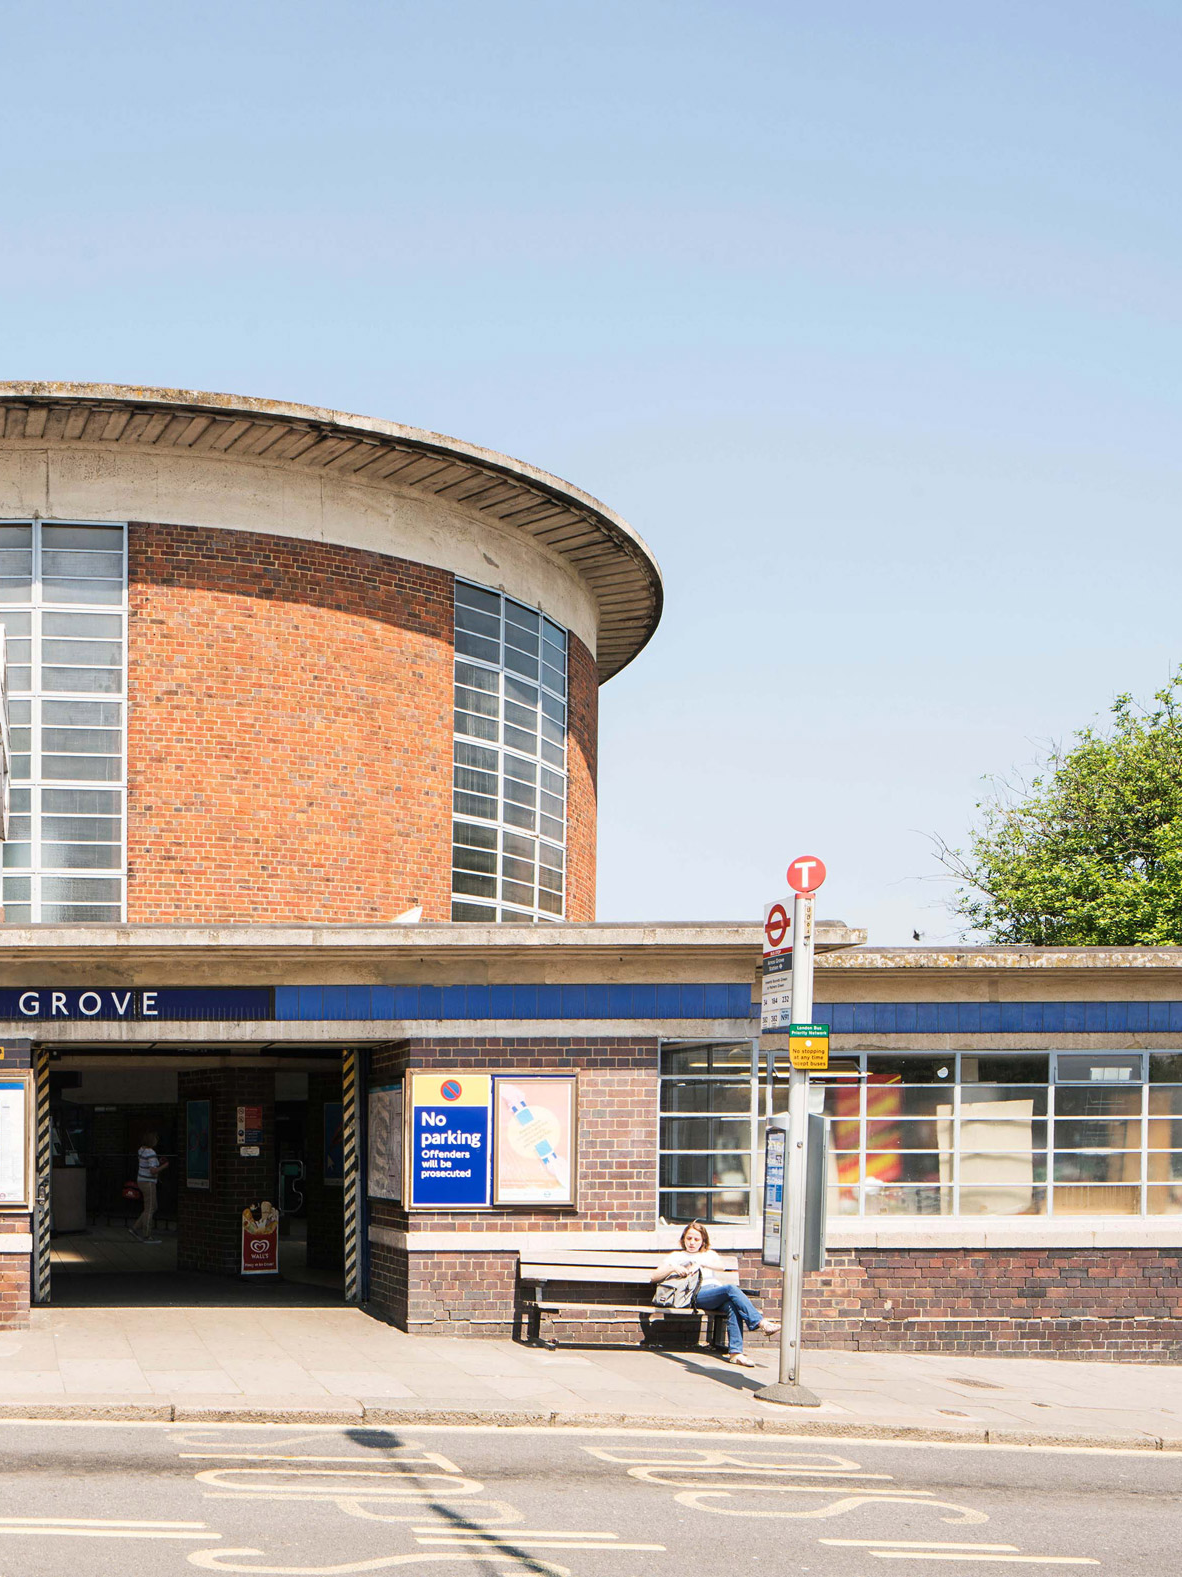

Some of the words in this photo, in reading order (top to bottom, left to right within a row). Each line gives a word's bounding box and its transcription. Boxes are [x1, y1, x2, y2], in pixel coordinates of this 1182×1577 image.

[794, 861, 816, 888] T
[18, 992, 158, 1016] GROVE
[421, 1111, 446, 1126] No
[421, 1130, 481, 1148] parking
[421, 1150, 470, 1159] Offenders
[421, 1159, 438, 1168] will
[440, 1159, 452, 1168] be
[421, 1168, 471, 1179] prosecuted
